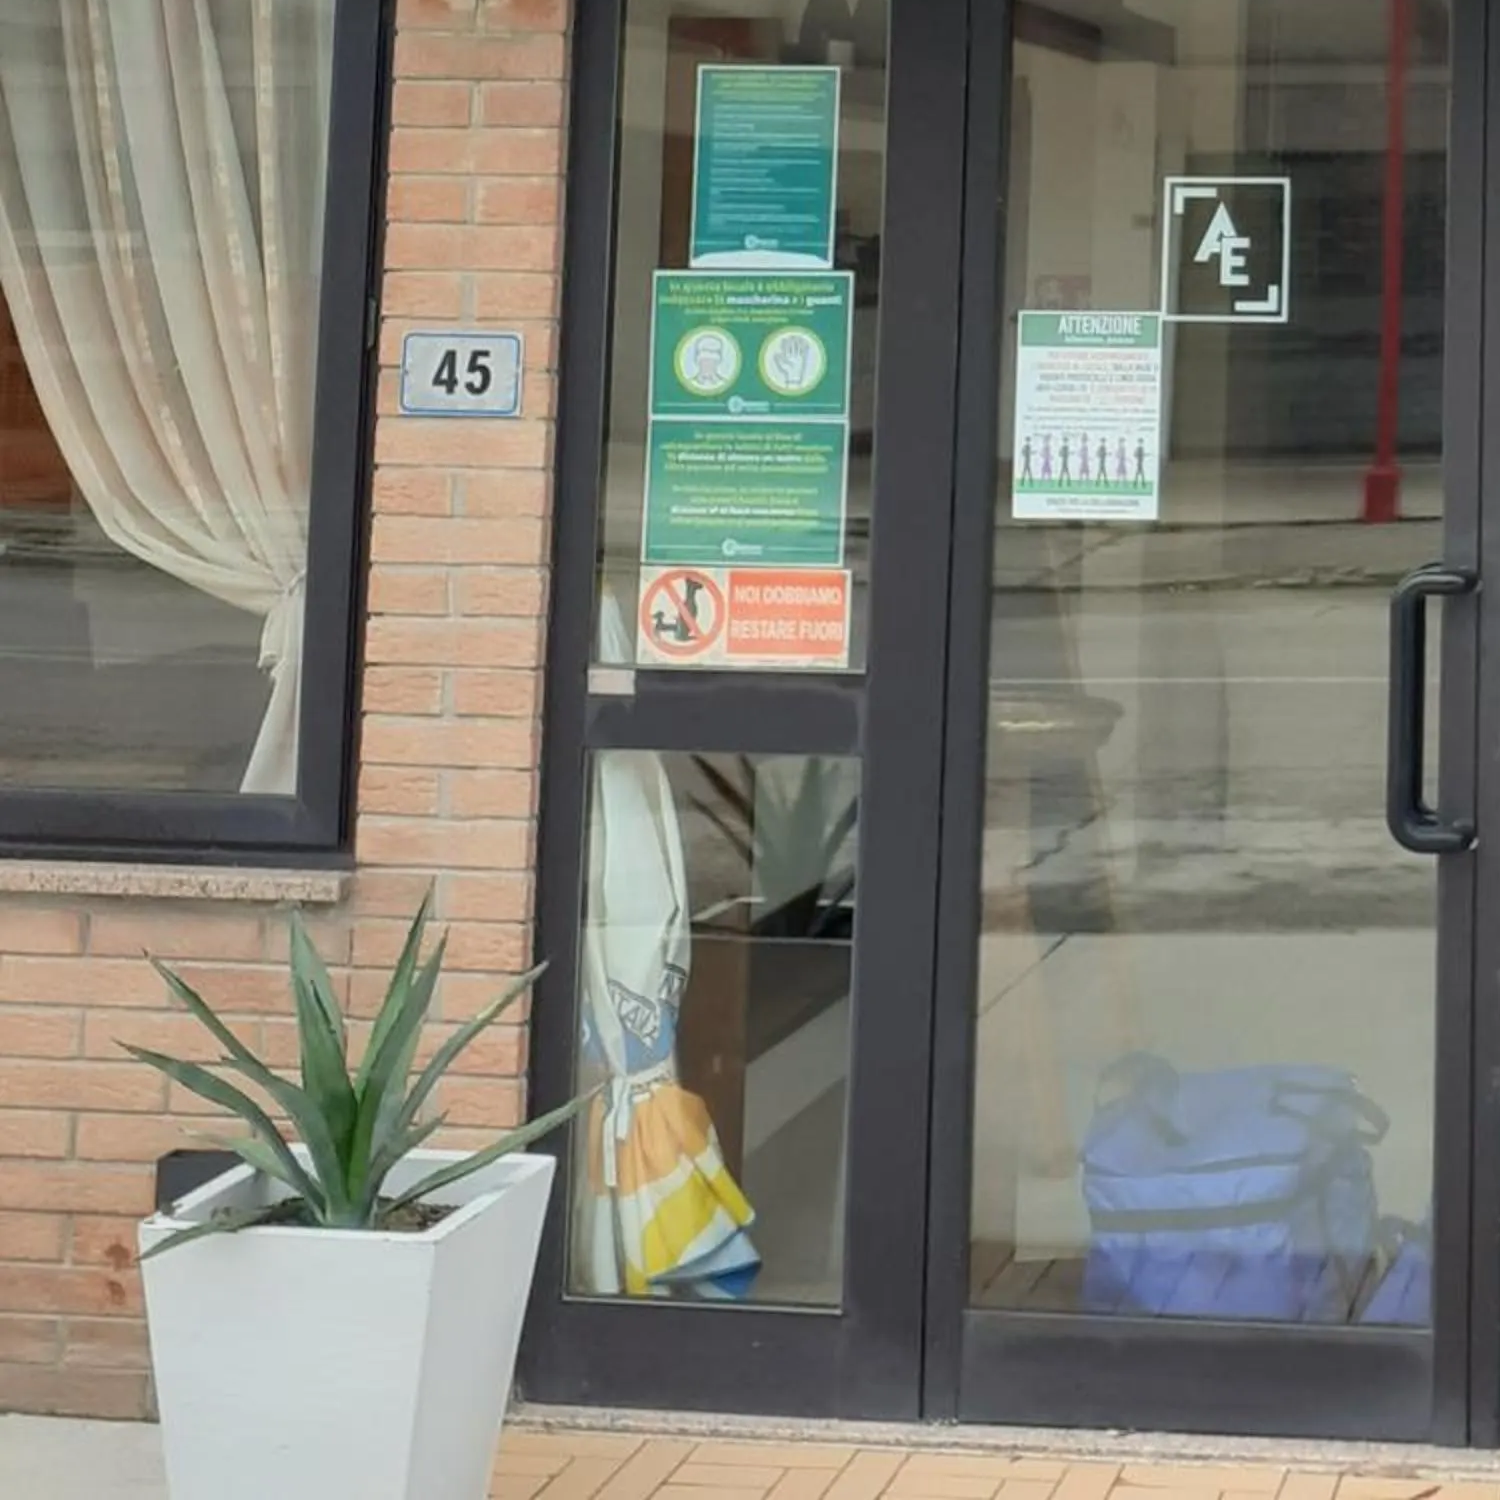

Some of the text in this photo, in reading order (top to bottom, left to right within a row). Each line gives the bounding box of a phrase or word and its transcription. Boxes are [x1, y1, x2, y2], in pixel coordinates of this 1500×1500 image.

[1058, 315, 1142, 336] ATTENZIONE
[432, 349, 492, 396] 45
[734, 584, 843, 607] NOI DOBBIAMO
[730, 618, 844, 641] RESTARE FUORI
